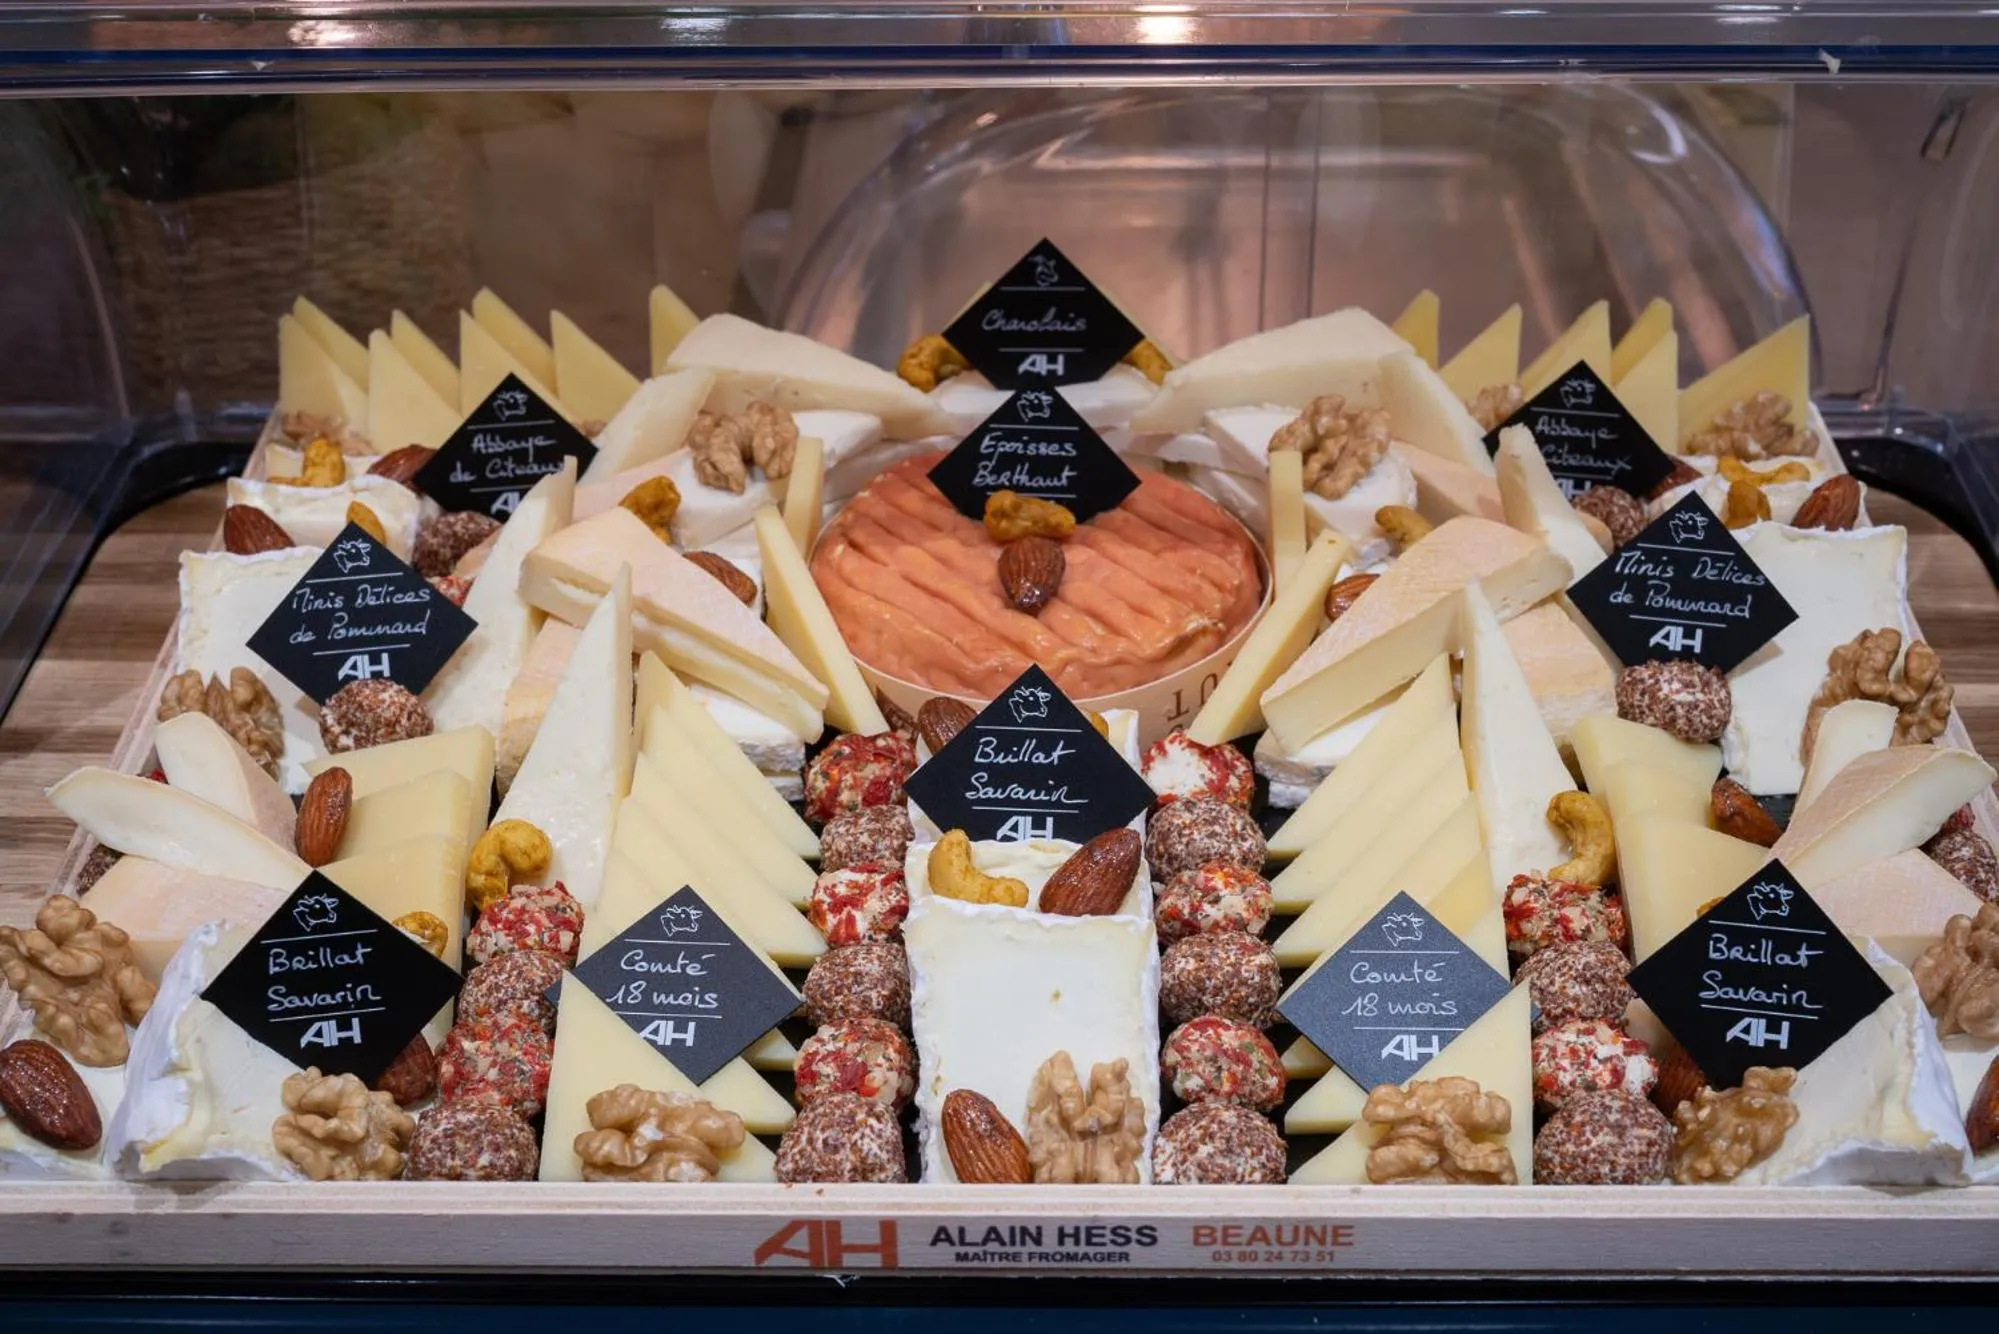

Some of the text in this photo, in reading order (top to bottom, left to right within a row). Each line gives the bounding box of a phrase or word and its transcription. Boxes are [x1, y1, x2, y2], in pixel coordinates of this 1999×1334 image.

[982, 306, 1087, 331] Charolais
[1018, 354, 1064, 376] AH
[450, 461, 476, 483] de
[1609, 582, 1635, 604] de
[289, 625, 316, 644] de
[1649, 625, 1703, 654] AH
[337, 652, 391, 681] AH
[974, 737, 1076, 765] Brillat
[964, 772, 1089, 803] Savarin
[996, 815, 1054, 841] AH
[268, 942, 372, 975] Brillat
[620, 949, 716, 976] Comté
[1707, 933, 1824, 968] Brillat
[1350, 959, 1446, 984] Comté
[267, 983, 382, 1011] Savarin
[606, 980, 718, 1009] 18 mois
[1699, 970, 1823, 1009] Savarin
[1341, 992, 1458, 1016] 18 mois
[300, 1017, 362, 1048] AH
[639, 1020, 696, 1047] AH
[1726, 1017, 1790, 1049] AH
[1381, 1034, 1440, 1061] AH
[754, 1219, 898, 1268] AH
[929, 1225, 1158, 1247] ALAIN HESS
[1192, 1225, 1354, 1247] BEAUNE
[955, 1249, 1130, 1263] MAÎTRE FROMAGER
[1212, 1250, 1335, 1263] 03 80 24 73 51
